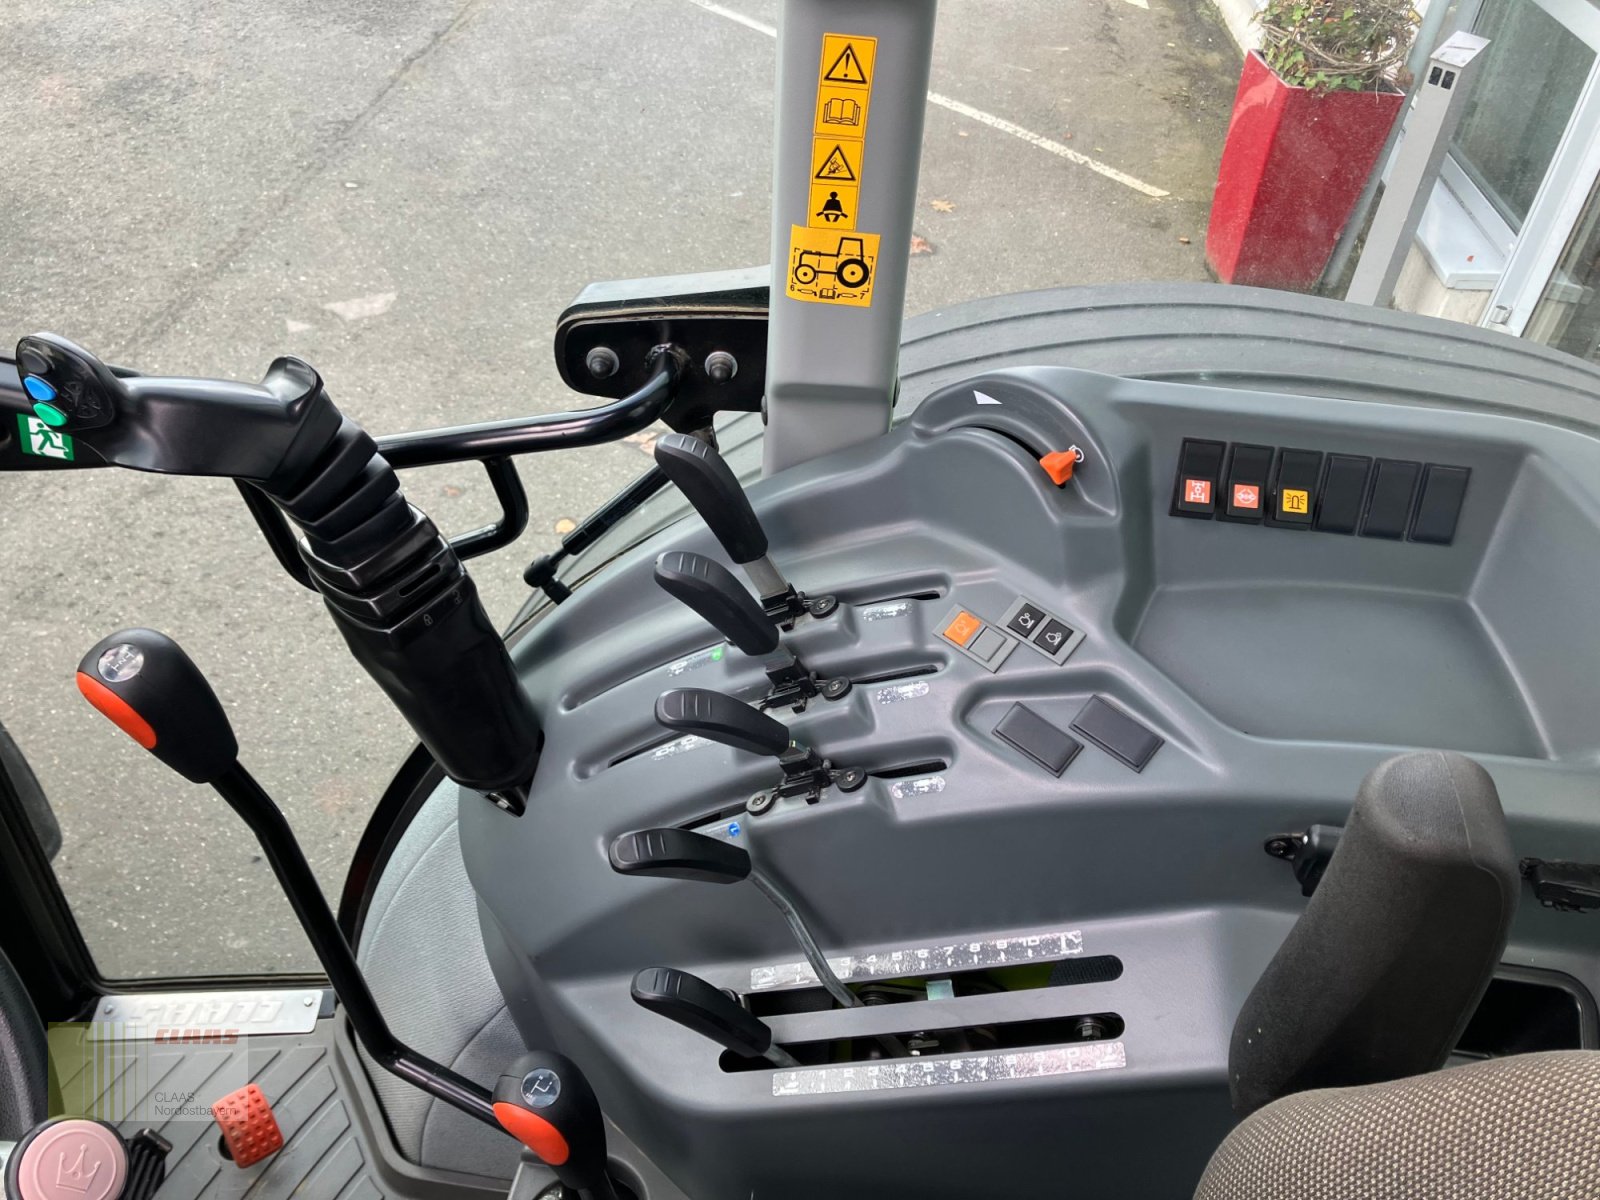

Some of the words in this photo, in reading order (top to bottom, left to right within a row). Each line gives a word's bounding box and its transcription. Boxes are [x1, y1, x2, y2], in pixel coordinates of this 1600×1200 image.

[866, 954, 877, 962] 4
[892, 951, 902, 960] 5
[917, 949, 929, 958] 6
[943, 946, 954, 955] 7
[969, 943, 981, 952] 8
[996, 939, 1008, 949] 9
[1021, 936, 1040, 946] 10
[895, 1064, 907, 1073] 4
[950, 1059, 962, 1069] 6
[978, 1057, 988, 1067] 7
